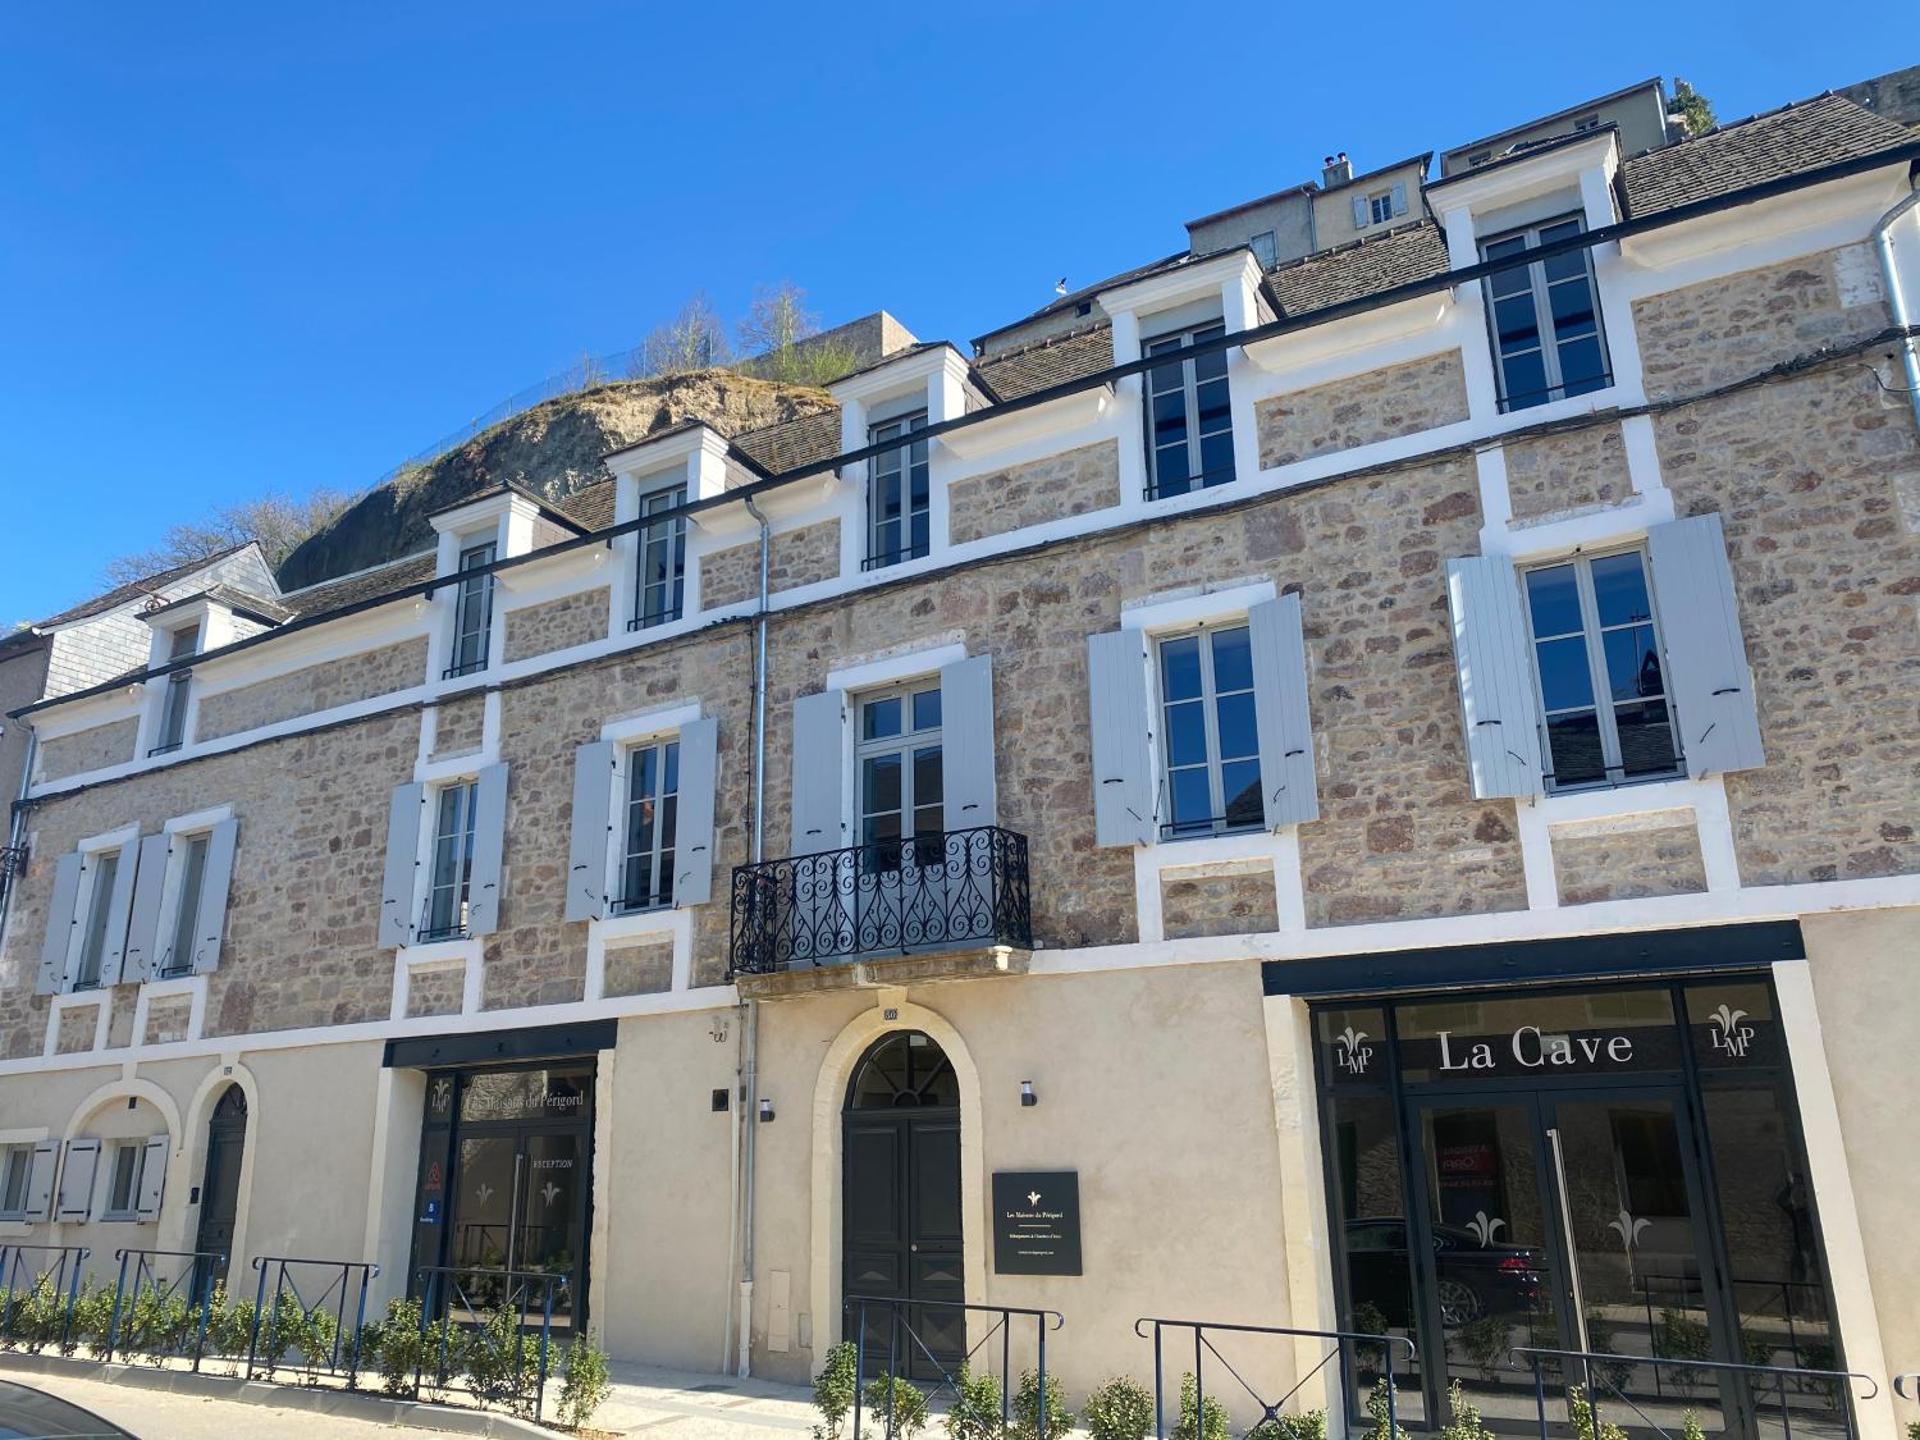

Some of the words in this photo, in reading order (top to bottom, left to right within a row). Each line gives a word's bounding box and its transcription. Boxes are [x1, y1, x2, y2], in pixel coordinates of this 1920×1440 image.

[1436, 1031, 1496, 1070] La
[1512, 1025, 1633, 1068] Cave
[539, 1089, 584, 1111] Périgord
